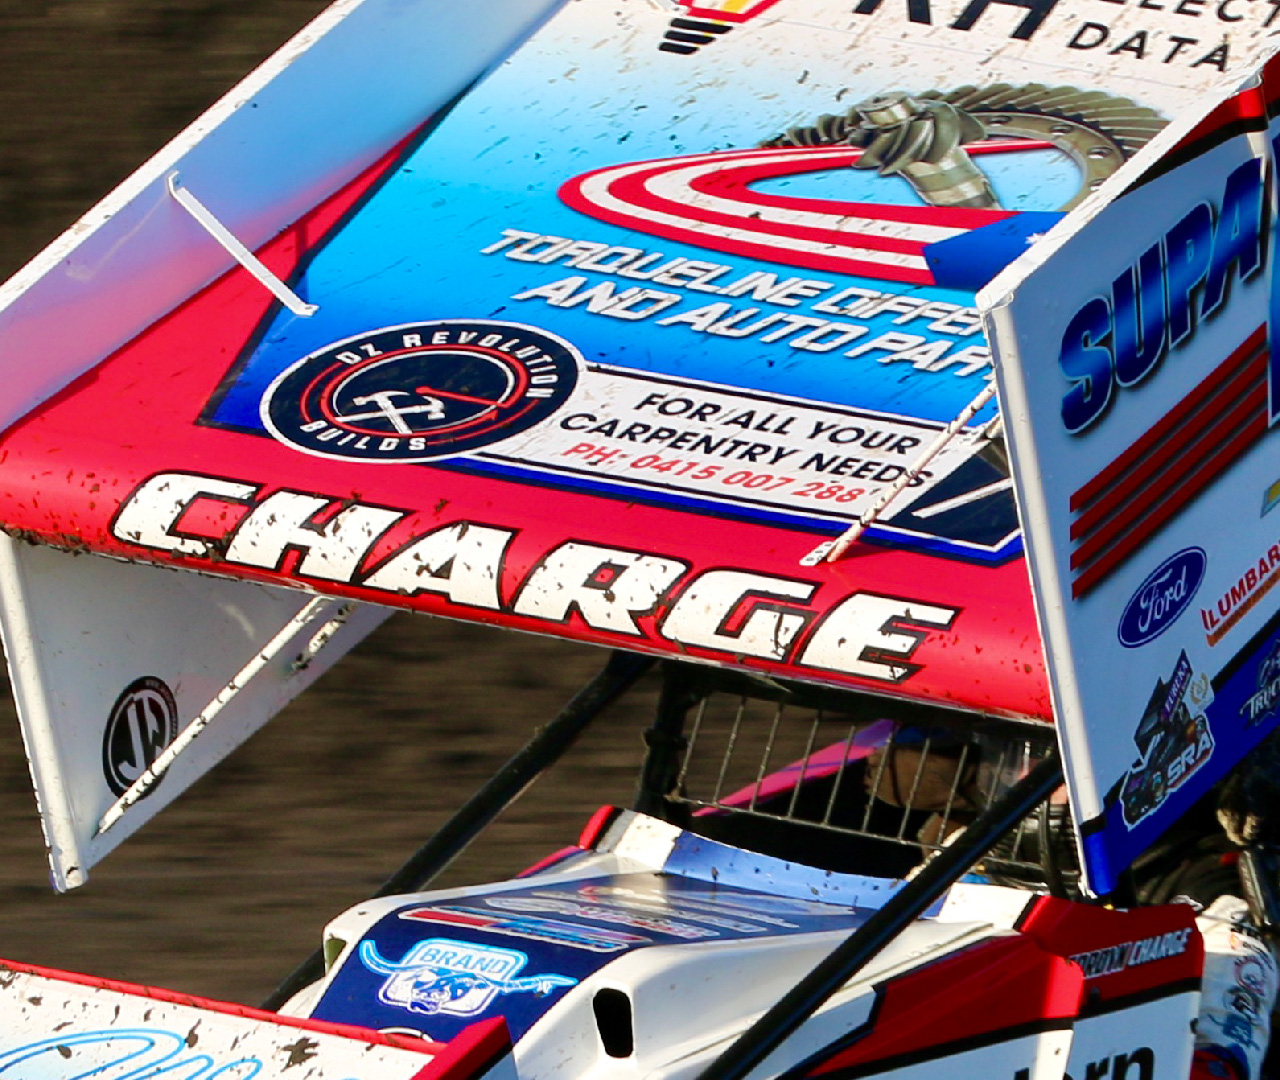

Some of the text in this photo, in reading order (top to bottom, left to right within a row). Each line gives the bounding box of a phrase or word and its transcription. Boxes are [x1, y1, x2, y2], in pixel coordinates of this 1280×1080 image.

[1068, 21, 1231, 73] DATA
[479, 228, 986, 338] TORQUELINE DIFFE
[1058, 156, 1263, 434] SUPA
[511, 275, 995, 381] AND AUTO PAR
[336, 331, 560, 398] OZ REVOLUTION
[300, 420, 427, 451] BUILDS
[559, 412, 935, 488] CARPENTRY NEEDS
[634, 393, 923, 455] FOR ALL YOUR
[560, 443, 865, 503] PH: 0415 007 288
[111, 471, 960, 681] CHARGE
[1138, 565, 1187, 633] Ford
[1167, 731, 1212, 782] SRA
[420, 947, 511, 975] BRAND
